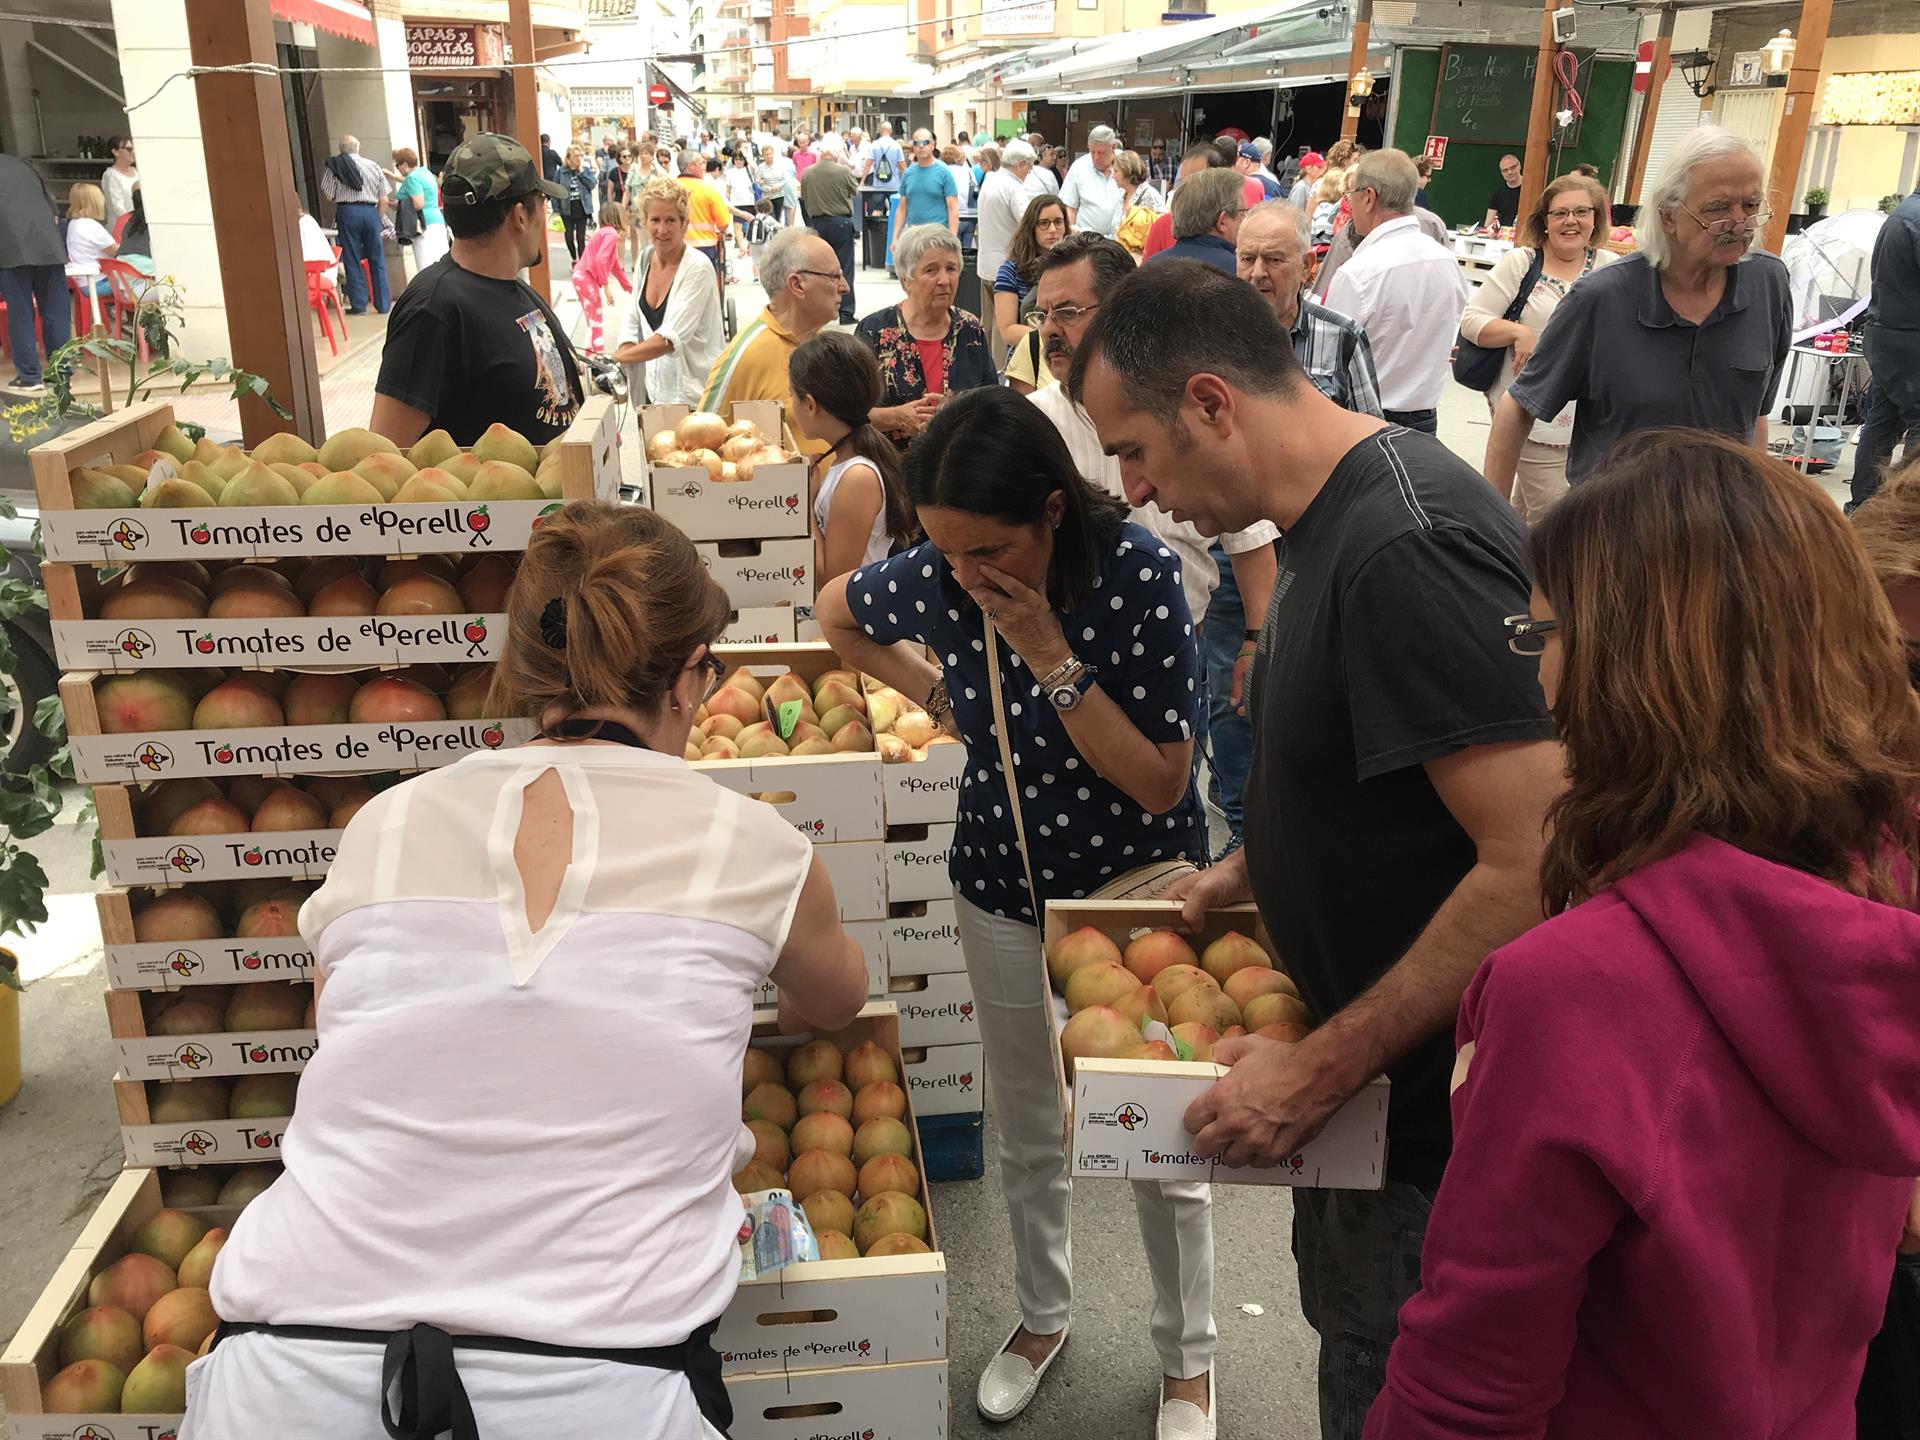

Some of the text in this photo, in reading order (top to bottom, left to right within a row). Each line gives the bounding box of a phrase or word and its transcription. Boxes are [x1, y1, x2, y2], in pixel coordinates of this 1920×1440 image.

[406, 28, 456, 41] TAPAS
[536, 406, 559, 426] ONE
[171, 517, 303, 545] Tomates
[316, 516, 352, 542] de
[176, 628, 305, 654] Tomates
[318, 628, 352, 652] de
[195, 737, 323, 765] Tomates
[336, 735, 370, 759] de
[225, 840, 336, 867] Tomate
[761, 982, 776, 992] de
[1142, 1150, 1206, 1165] Tomates
[783, 1346, 800, 1358] de
